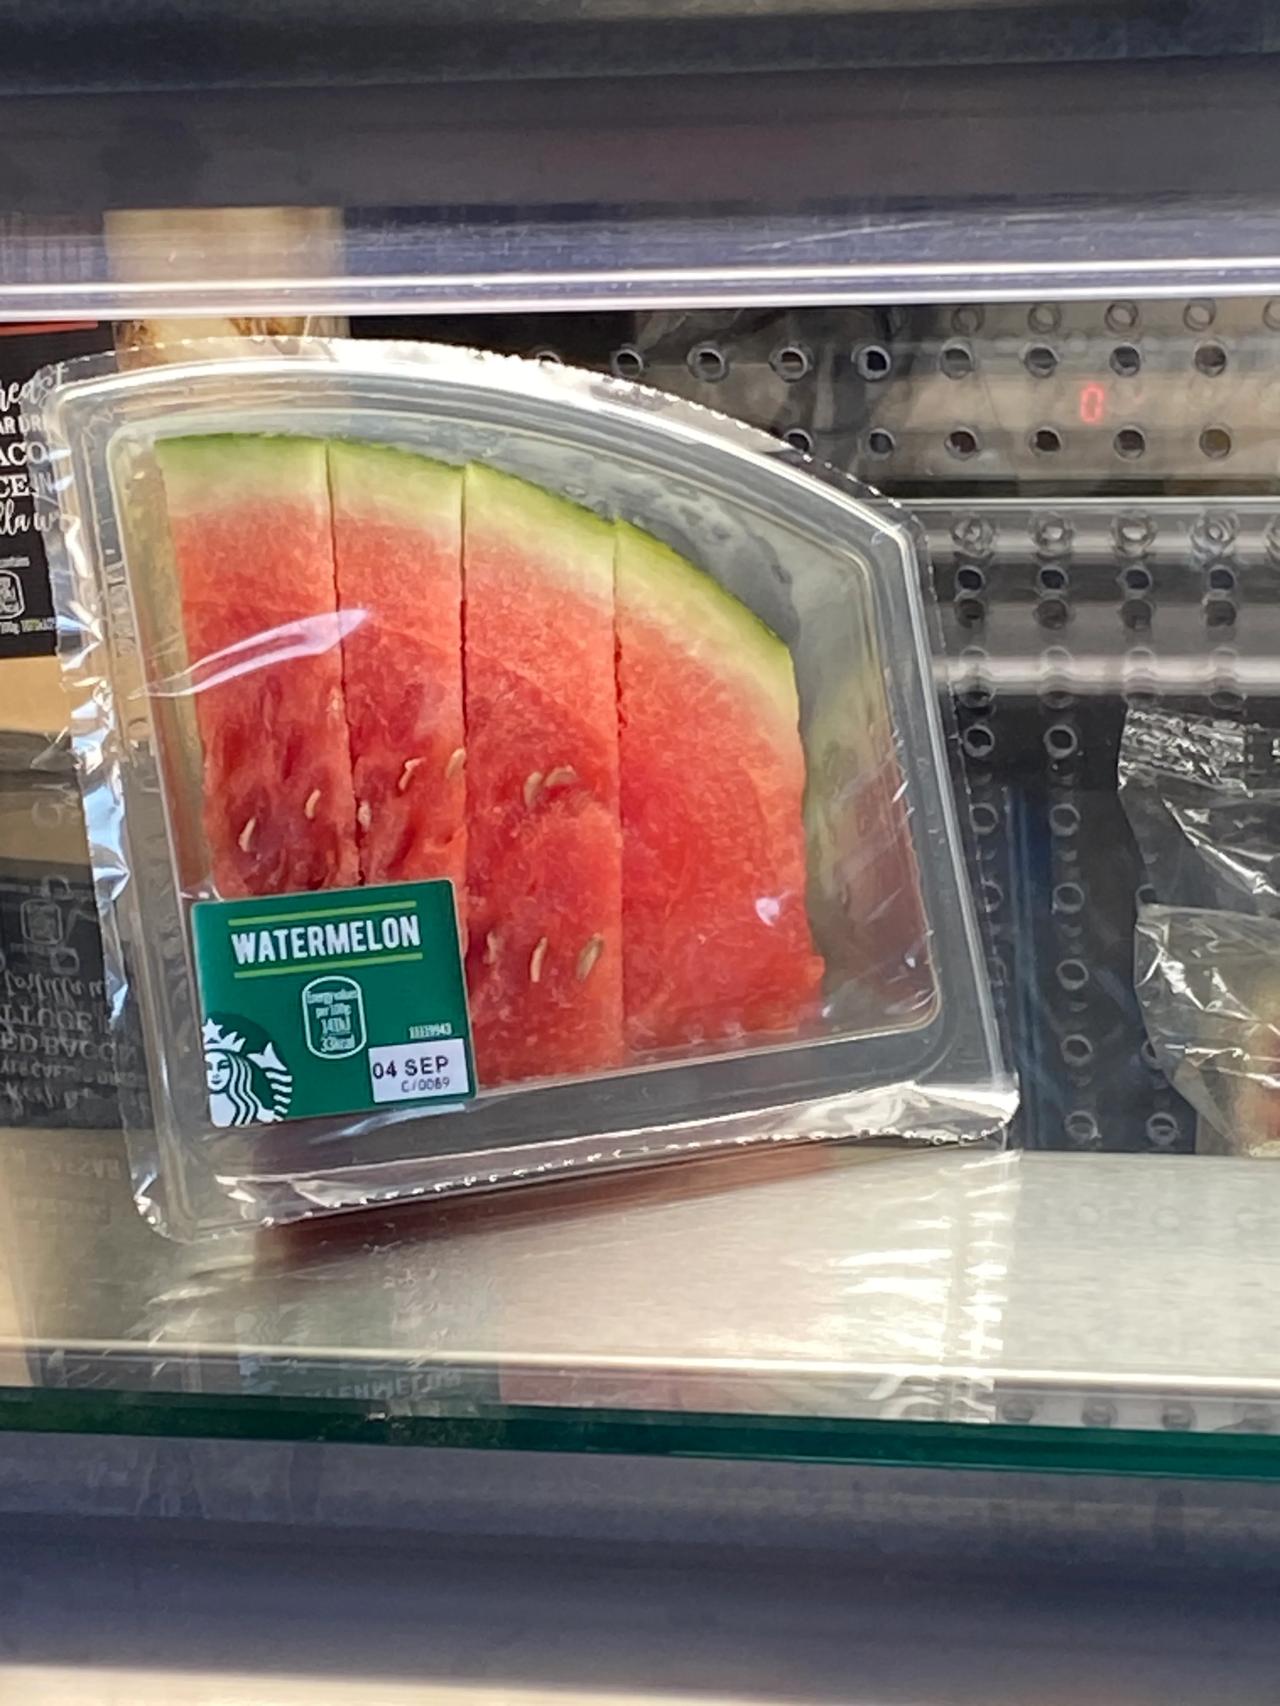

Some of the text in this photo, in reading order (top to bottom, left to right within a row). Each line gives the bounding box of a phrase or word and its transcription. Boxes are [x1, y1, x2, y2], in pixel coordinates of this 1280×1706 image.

[231, 915, 420, 964] WATERMELON
[372, 1054, 450, 1080] 04 SEP
